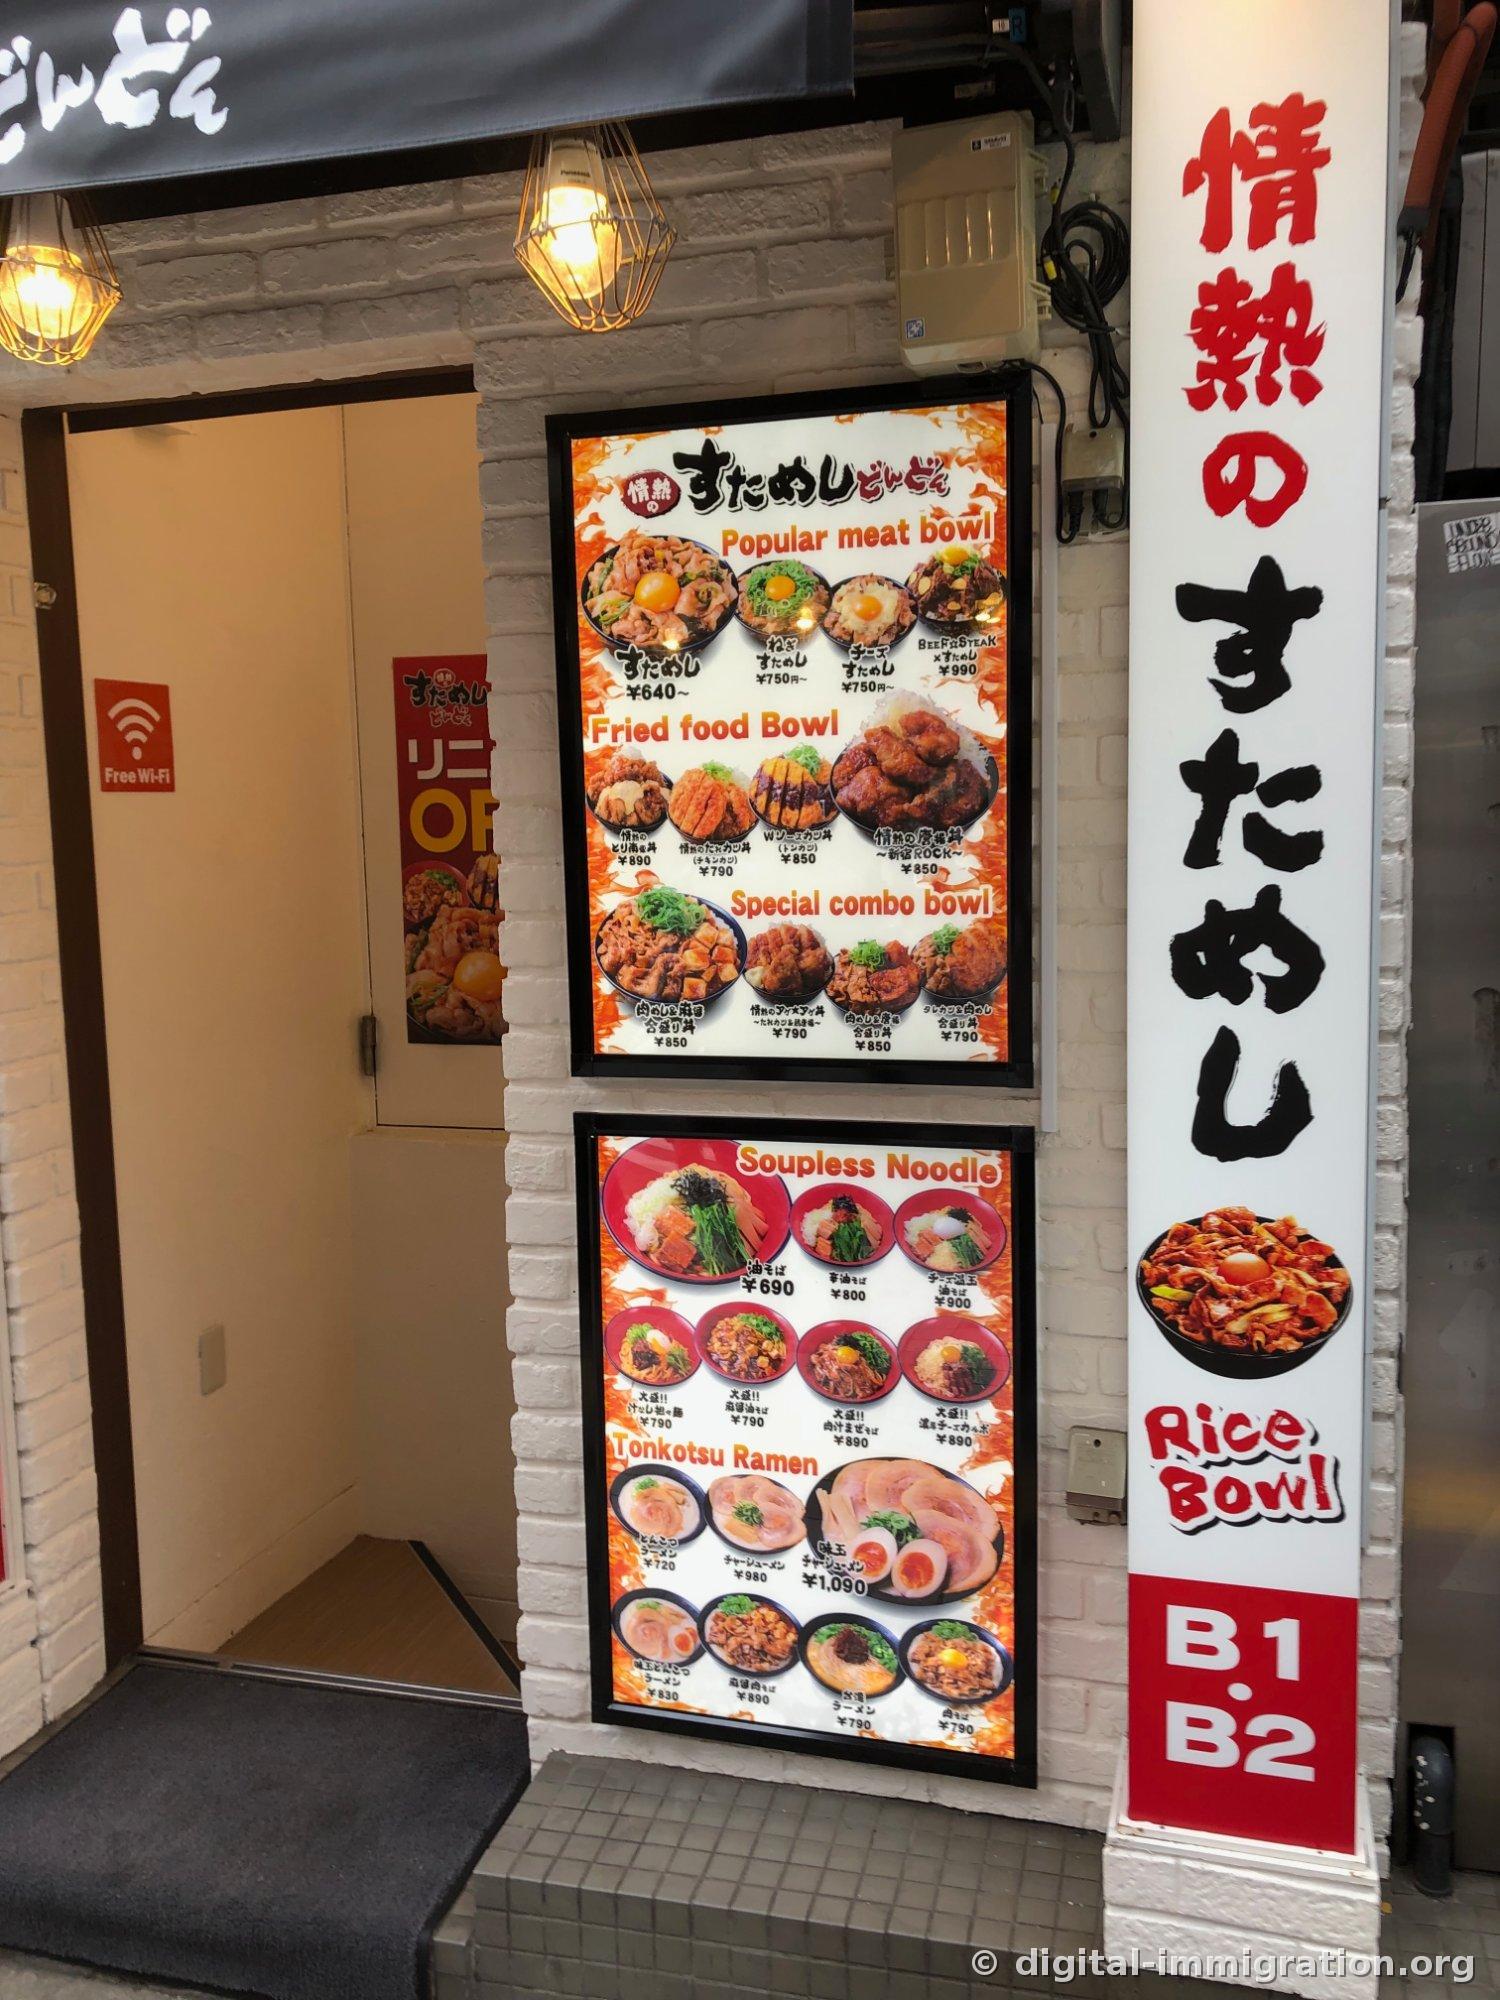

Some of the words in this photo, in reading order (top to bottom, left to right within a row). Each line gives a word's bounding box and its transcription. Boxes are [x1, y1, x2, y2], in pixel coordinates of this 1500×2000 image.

[722, 524, 828, 559] Popular
[838, 518, 911, 549] meat
[921, 510, 995, 543] bowl
[850, 643, 889, 661] チーズ
[616, 645, 701, 680] すためし
[757, 652, 808, 670] すためし
[842, 660, 895, 679] すためし
[939, 665, 977, 676] ¥990
[592, 716, 669, 743] Fried
[681, 712, 749, 741] food
[762, 709, 838, 738] Bowl
[104, 767, 137, 784] Free
[137, 767, 170, 784] Wi-Fi
[618, 855, 651, 866] ¥890
[781, 853, 816, 864] ¥850
[699, 866, 733, 877] ¥790
[902, 863, 938, 875] ¥850
[731, 889, 819, 919] Special
[830, 889, 915, 916] combo
[925, 888, 989, 915] bowl
[773, 1028, 807, 1039] ¥790
[941, 1031, 978, 1042] ¥790
[654, 1036, 687, 1047] ¥850
[856, 1041, 891, 1052] ¥850
[740, 1146, 875, 1178] Soupless
[888, 1153, 999, 1185] Noodle
[748, 1261, 788, 1276] 油そば
[742, 1277, 794, 1296] ¥690
[831, 1289, 866, 1301] ¥800
[935, 1296, 971, 1309] ¥900
[640, 1416, 672, 1429] ¥790
[731, 1415, 764, 1427] ¥790
[1145, 1402, 1306, 1460] Rice
[834, 1435, 868, 1448] ¥890
[936, 1434, 972, 1447] ¥890
[613, 1432, 724, 1467] Tonkotsu
[733, 1443, 818, 1476] Ramen
[1160, 1453, 1333, 1524] Bowl
[640, 1546, 678, 1558] ラーメン
[644, 1558, 676, 1571] ¥720
[734, 1569, 767, 1583] ¥980
[803, 1572, 866, 1595] ¥1,090
[645, 1673, 681, 1687] ラーメン
[648, 1688, 680, 1701] ¥830
[737, 1690, 770, 1705] ¥890
[832, 1700, 876, 1715] ラーメン
[837, 1715, 872, 1730] ¥790
[938, 1719, 975, 1735] ¥790
[1166, 1700, 1317, 1783] B2
